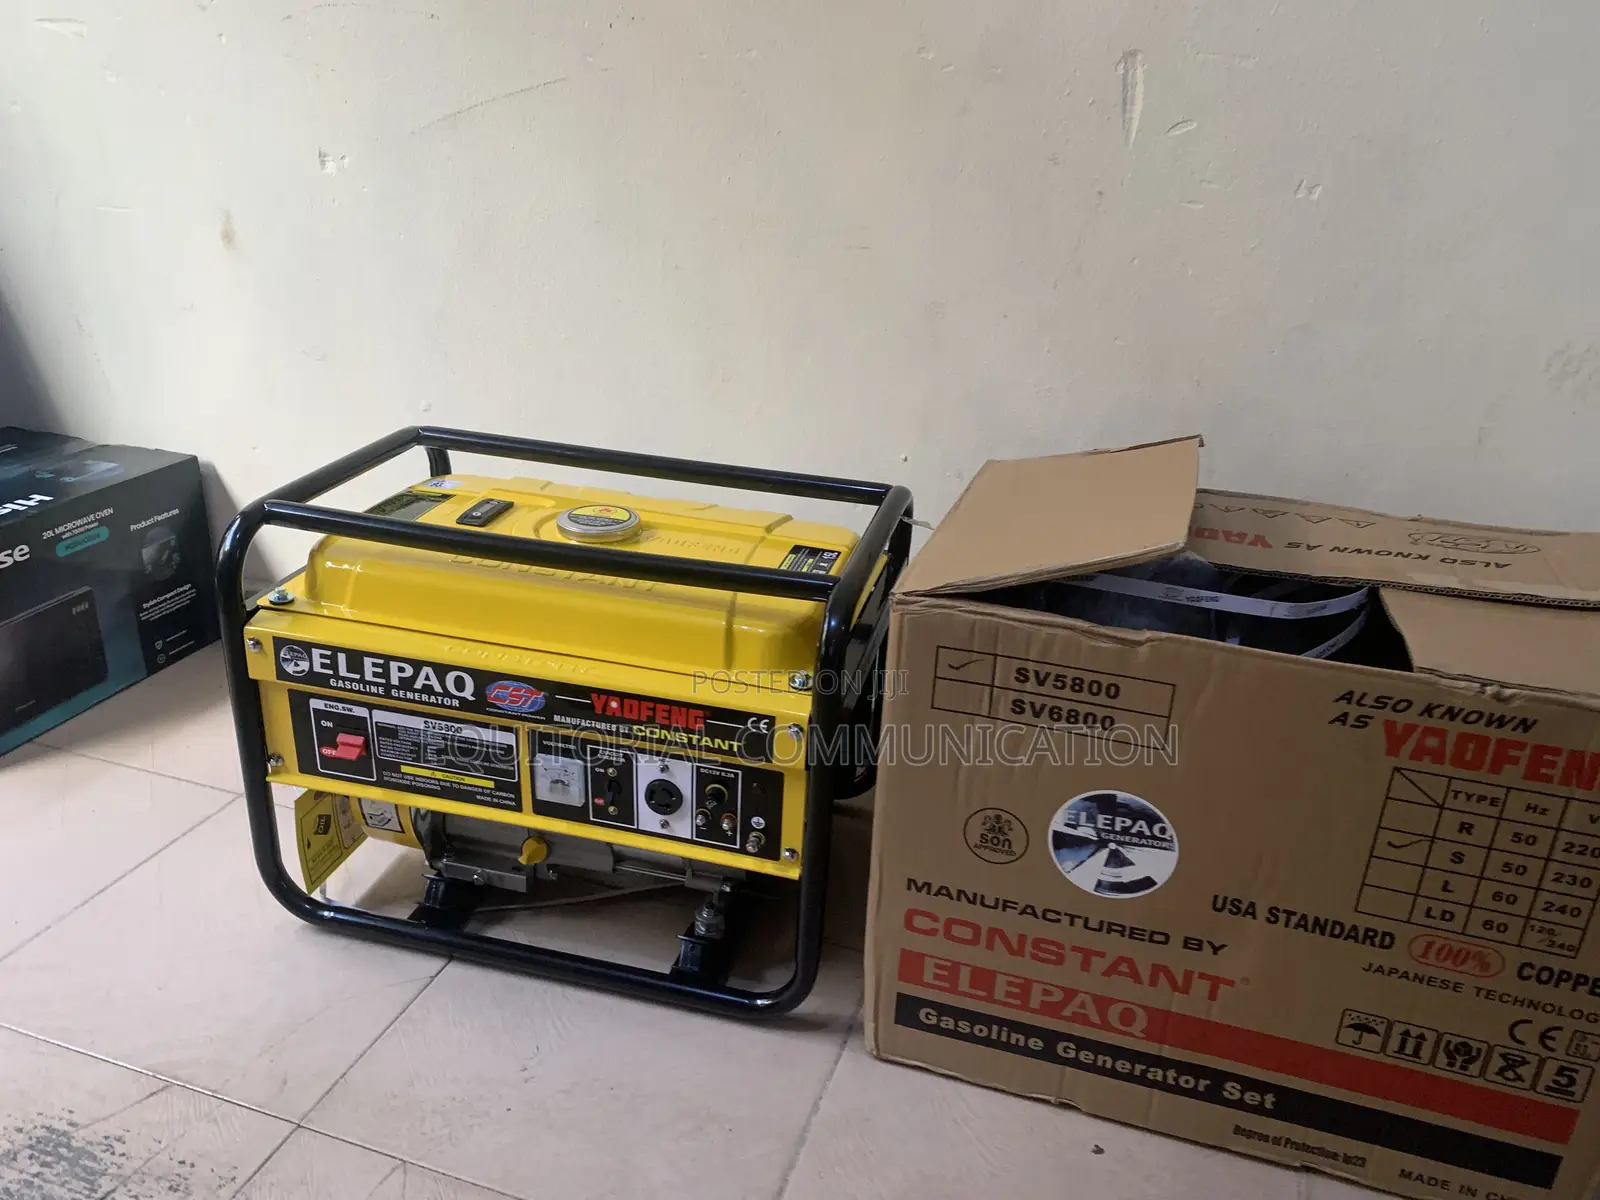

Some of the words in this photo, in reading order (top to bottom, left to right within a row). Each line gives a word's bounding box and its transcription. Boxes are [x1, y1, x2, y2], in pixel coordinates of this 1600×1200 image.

[42, 529, 55, 540] 20L
[55, 513, 96, 535] MICROWAVE
[95, 506, 114, 519] OVEN
[130, 517, 154, 531] Product
[154, 508, 180, 522] Features
[1284, 541, 1324, 551] AS
[1329, 546, 1432, 562] KNOWN
[1439, 557, 1513, 569] ALSO
[311, 647, 476, 701] ELEPAQ
[1014, 666, 1121, 700] SV5800
[329, 677, 386, 696] GASOLINE
[391, 688, 460, 708] GENERATOR
[487, 685, 545, 708] CST
[320, 719, 333, 728] ON
[590, 692, 705, 729] YAOFENG
[1010, 698, 1116, 731] SV6800
[1333, 690, 1413, 713] ALSO
[1419, 702, 1539, 734] KNOWN
[553, 714, 617, 733] MANUFACTURED
[632, 724, 743, 752] CONSTANT
[322, 748, 337, 756] OFF
[1328, 711, 1374, 730] AS
[1383, 719, 1600, 792] YAOFEN
[415, 775, 439, 785] INDOORS
[440, 780, 452, 788] DUE
[460, 784, 483, 793] DANGER
[491, 789, 515, 799] CARBON
[441, 773, 466, 783] CAUTION
[1451, 789, 1501, 808] TYPE
[1524, 802, 1549, 816] Hz
[1063, 810, 1173, 840] ELEPAQ
[1457, 821, 1476, 836] R
[1511, 831, 1538, 847] 50
[1561, 841, 1600, 859] 220
[973, 843, 1017, 857] APPROVED
[979, 832, 1013, 850] son
[1100, 832, 1177, 850] GENERATORS
[1450, 850, 1466, 865] S
[1501, 861, 1528, 877] 50
[1551, 871, 1593, 889] 230
[1441, 879, 1454, 894] L
[1491, 890, 1518, 906] 60
[1540, 901, 1582, 919] 240
[906, 877, 1170, 946] MANUFACTURED
[1181, 936, 1229, 956] BY
[1424, 906, 1456, 923] LD
[1481, 919, 1509, 934] 60
[1211, 894, 1258, 921] USA
[1265, 906, 1397, 951] STANDARD
[1415, 938, 1493, 975] 100%
[904, 908, 1236, 1002] CONSTANT
[1361, 961, 1465, 994] JAPANESE
[922, 958, 1149, 1039] ELEPAQ
[918, 1006, 1044, 1051] Gasoline
[1056, 1041, 1211, 1092] Generator
[1222, 1080, 1277, 1109] Set
[1552, 1065, 1579, 1088] 5
[1399, 1168, 1451, 1191] MADE
[1458, 1184, 1479, 1198] IN
